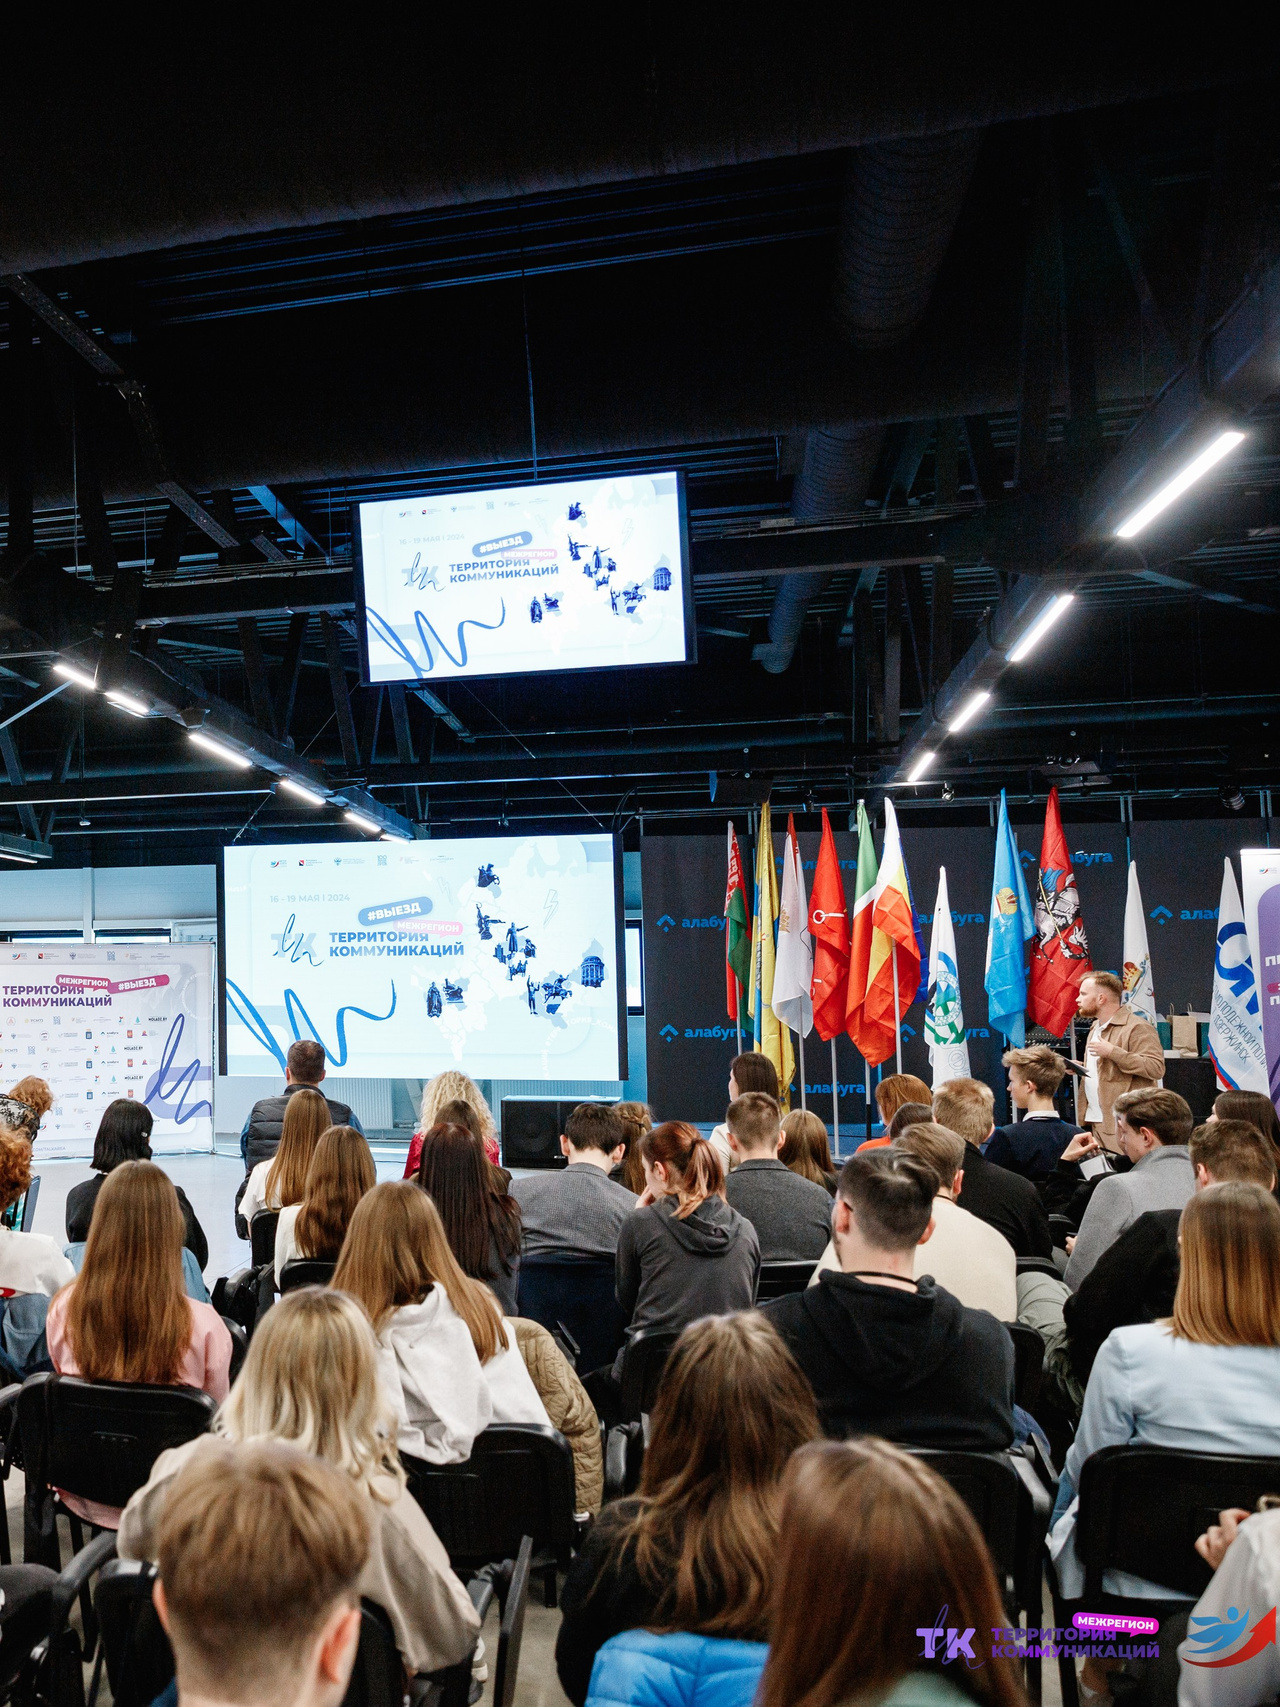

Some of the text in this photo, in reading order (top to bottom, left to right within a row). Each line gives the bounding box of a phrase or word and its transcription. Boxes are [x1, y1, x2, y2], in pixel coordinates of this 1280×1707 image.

[479, 535, 524, 553] #ВЫЕЗД
[449, 559, 530, 572] ТЕРРИТОРИЯ
[449, 564, 559, 583] КОММУНИКАЦИЙ
[270, 895, 279, 903] 16
[328, 894, 351, 902] 2024
[367, 902, 422, 921] #ВЫЕЗД
[681, 915, 727, 931] алабу
[918, 911, 985, 927] албуга
[397, 921, 460, 932] МЕЖРЕГИОН
[329, 931, 429, 943] ТЕРРИТОРИЯ
[329, 942, 465, 957] КОММУНИКАЦИЙ
[58, 976, 109, 987] МЕЖРЕГИОН
[118, 978, 157, 991] #ВЫЕЗД
[2, 985, 85, 995] ТЕРРИТОРИЯ
[2, 995, 113, 1008] КОММУНИКАЦИЙ
